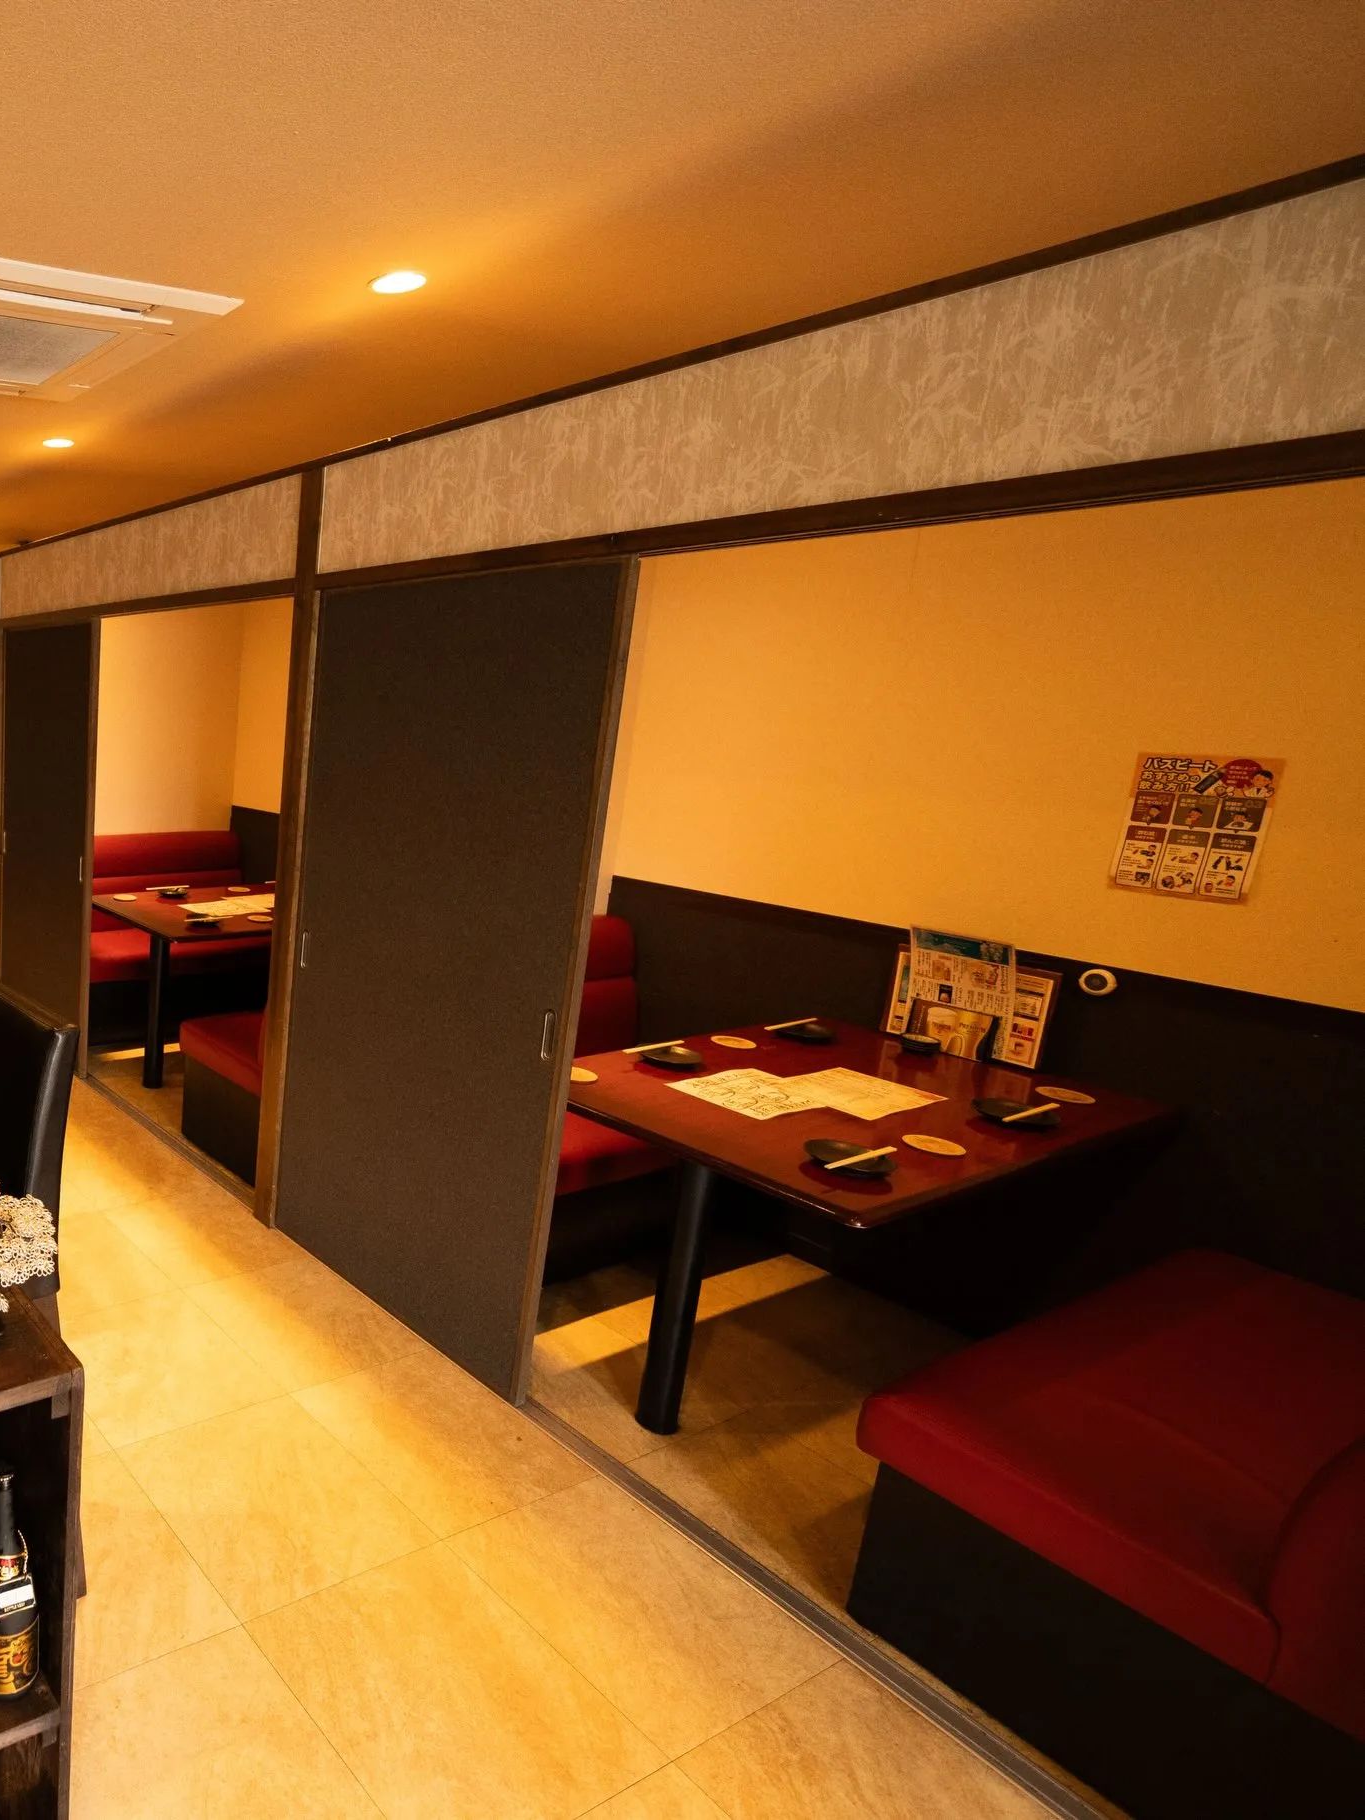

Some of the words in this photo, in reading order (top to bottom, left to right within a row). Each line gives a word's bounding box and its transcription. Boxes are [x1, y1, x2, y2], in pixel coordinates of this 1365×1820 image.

[1143, 757, 1218, 772] バズビート
[1141, 770, 1201, 783] おすすめの
